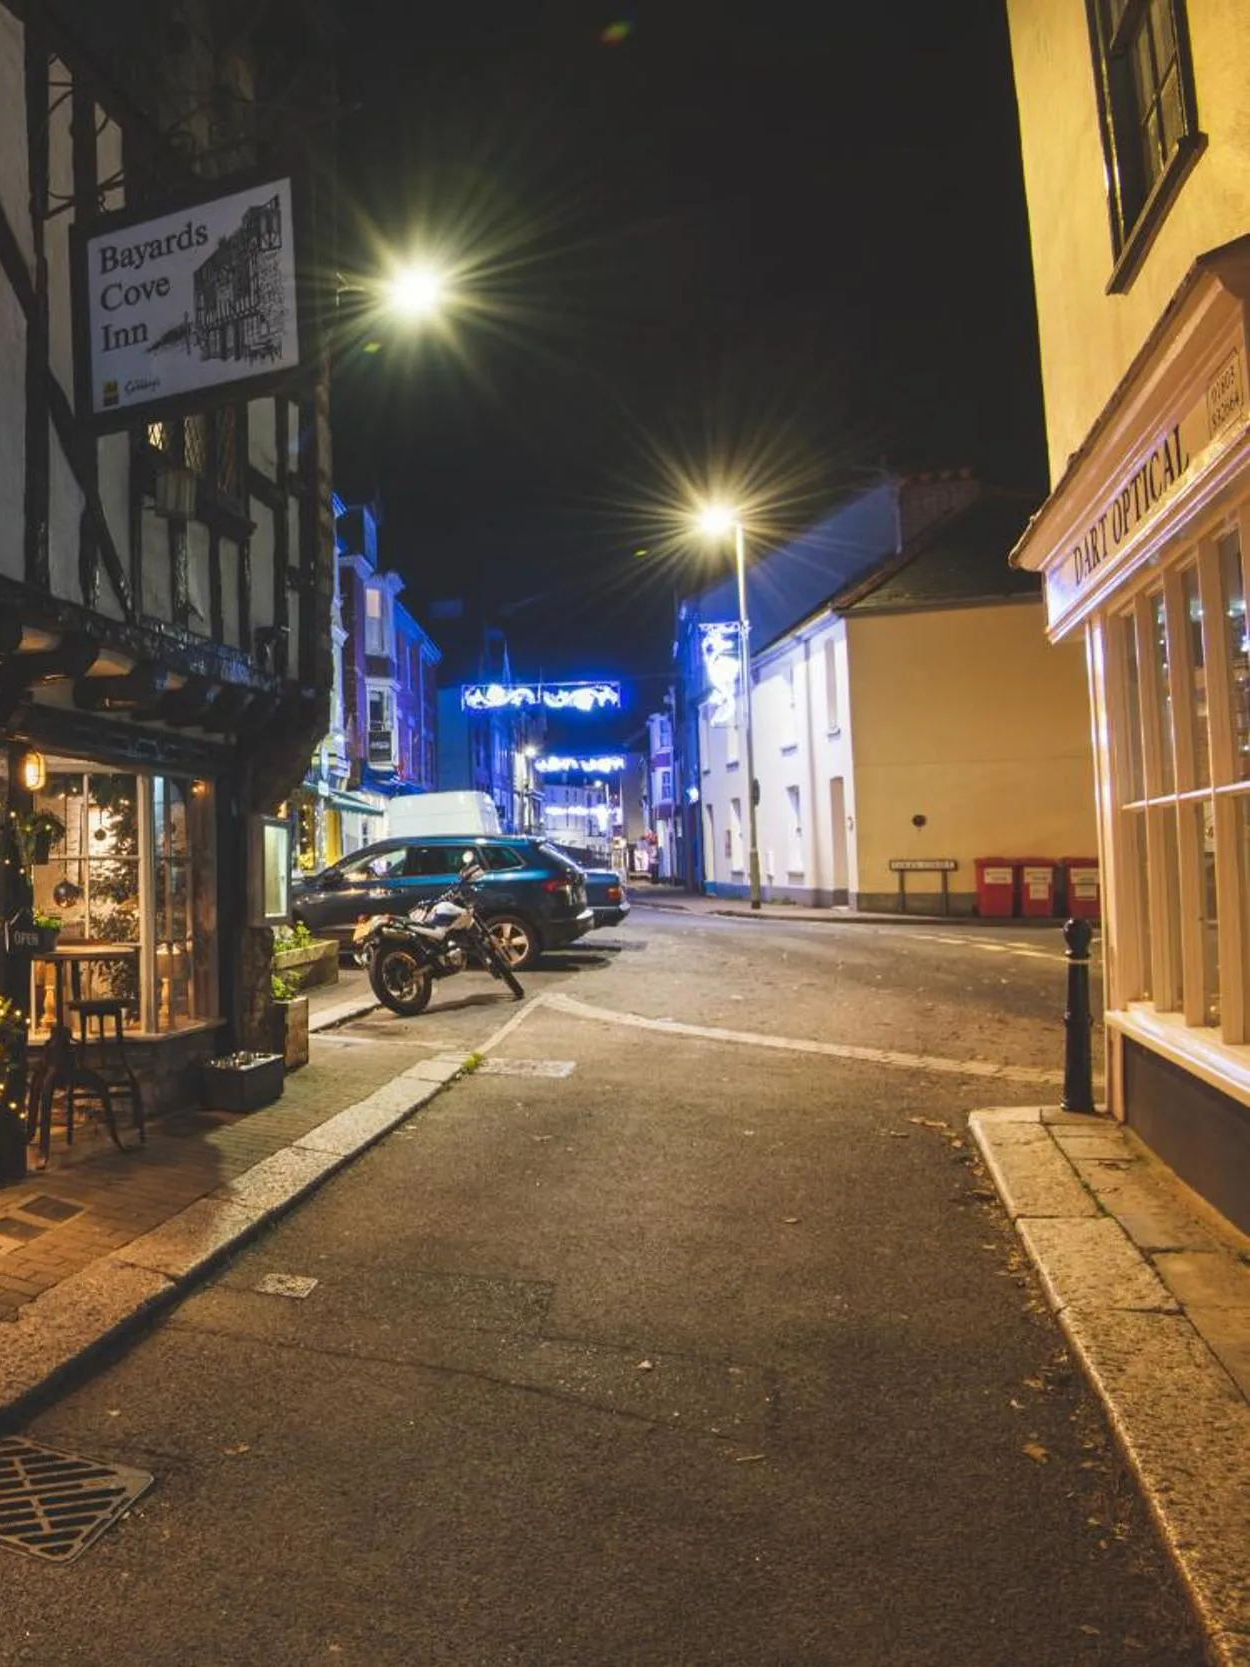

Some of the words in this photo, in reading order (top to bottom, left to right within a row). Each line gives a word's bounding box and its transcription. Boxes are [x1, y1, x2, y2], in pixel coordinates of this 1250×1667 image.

[100, 220, 209, 274] Bayards
[101, 276, 171, 312] Cove
[102, 322, 149, 352] Inn
[1073, 514, 1108, 587] DART
[1112, 423, 1190, 545] OPTICAL
[14, 930, 39, 946] OPEN
